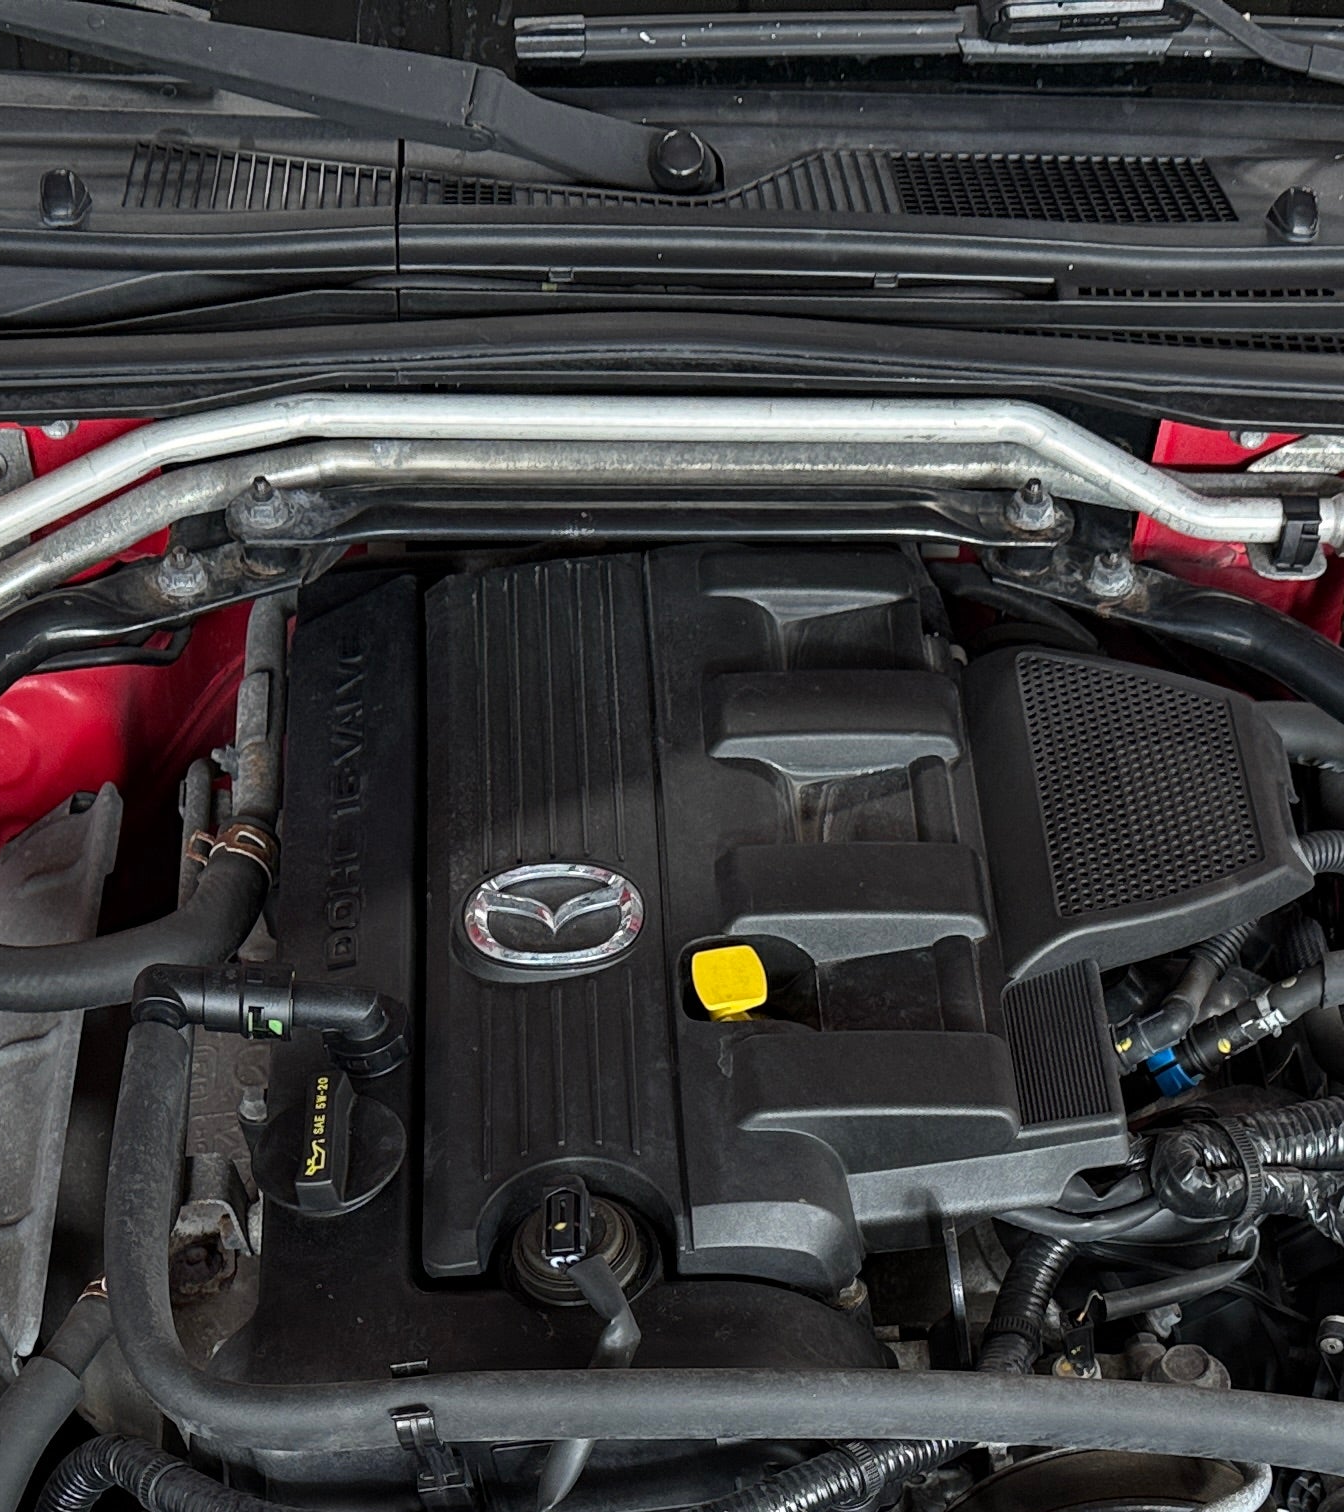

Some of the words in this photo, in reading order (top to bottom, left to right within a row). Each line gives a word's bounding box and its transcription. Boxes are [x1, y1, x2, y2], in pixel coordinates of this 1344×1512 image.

[323, 832, 360, 972] DOHC
[315, 1076, 329, 1109] 5W-20
[313, 1114, 326, 1135] SAE
